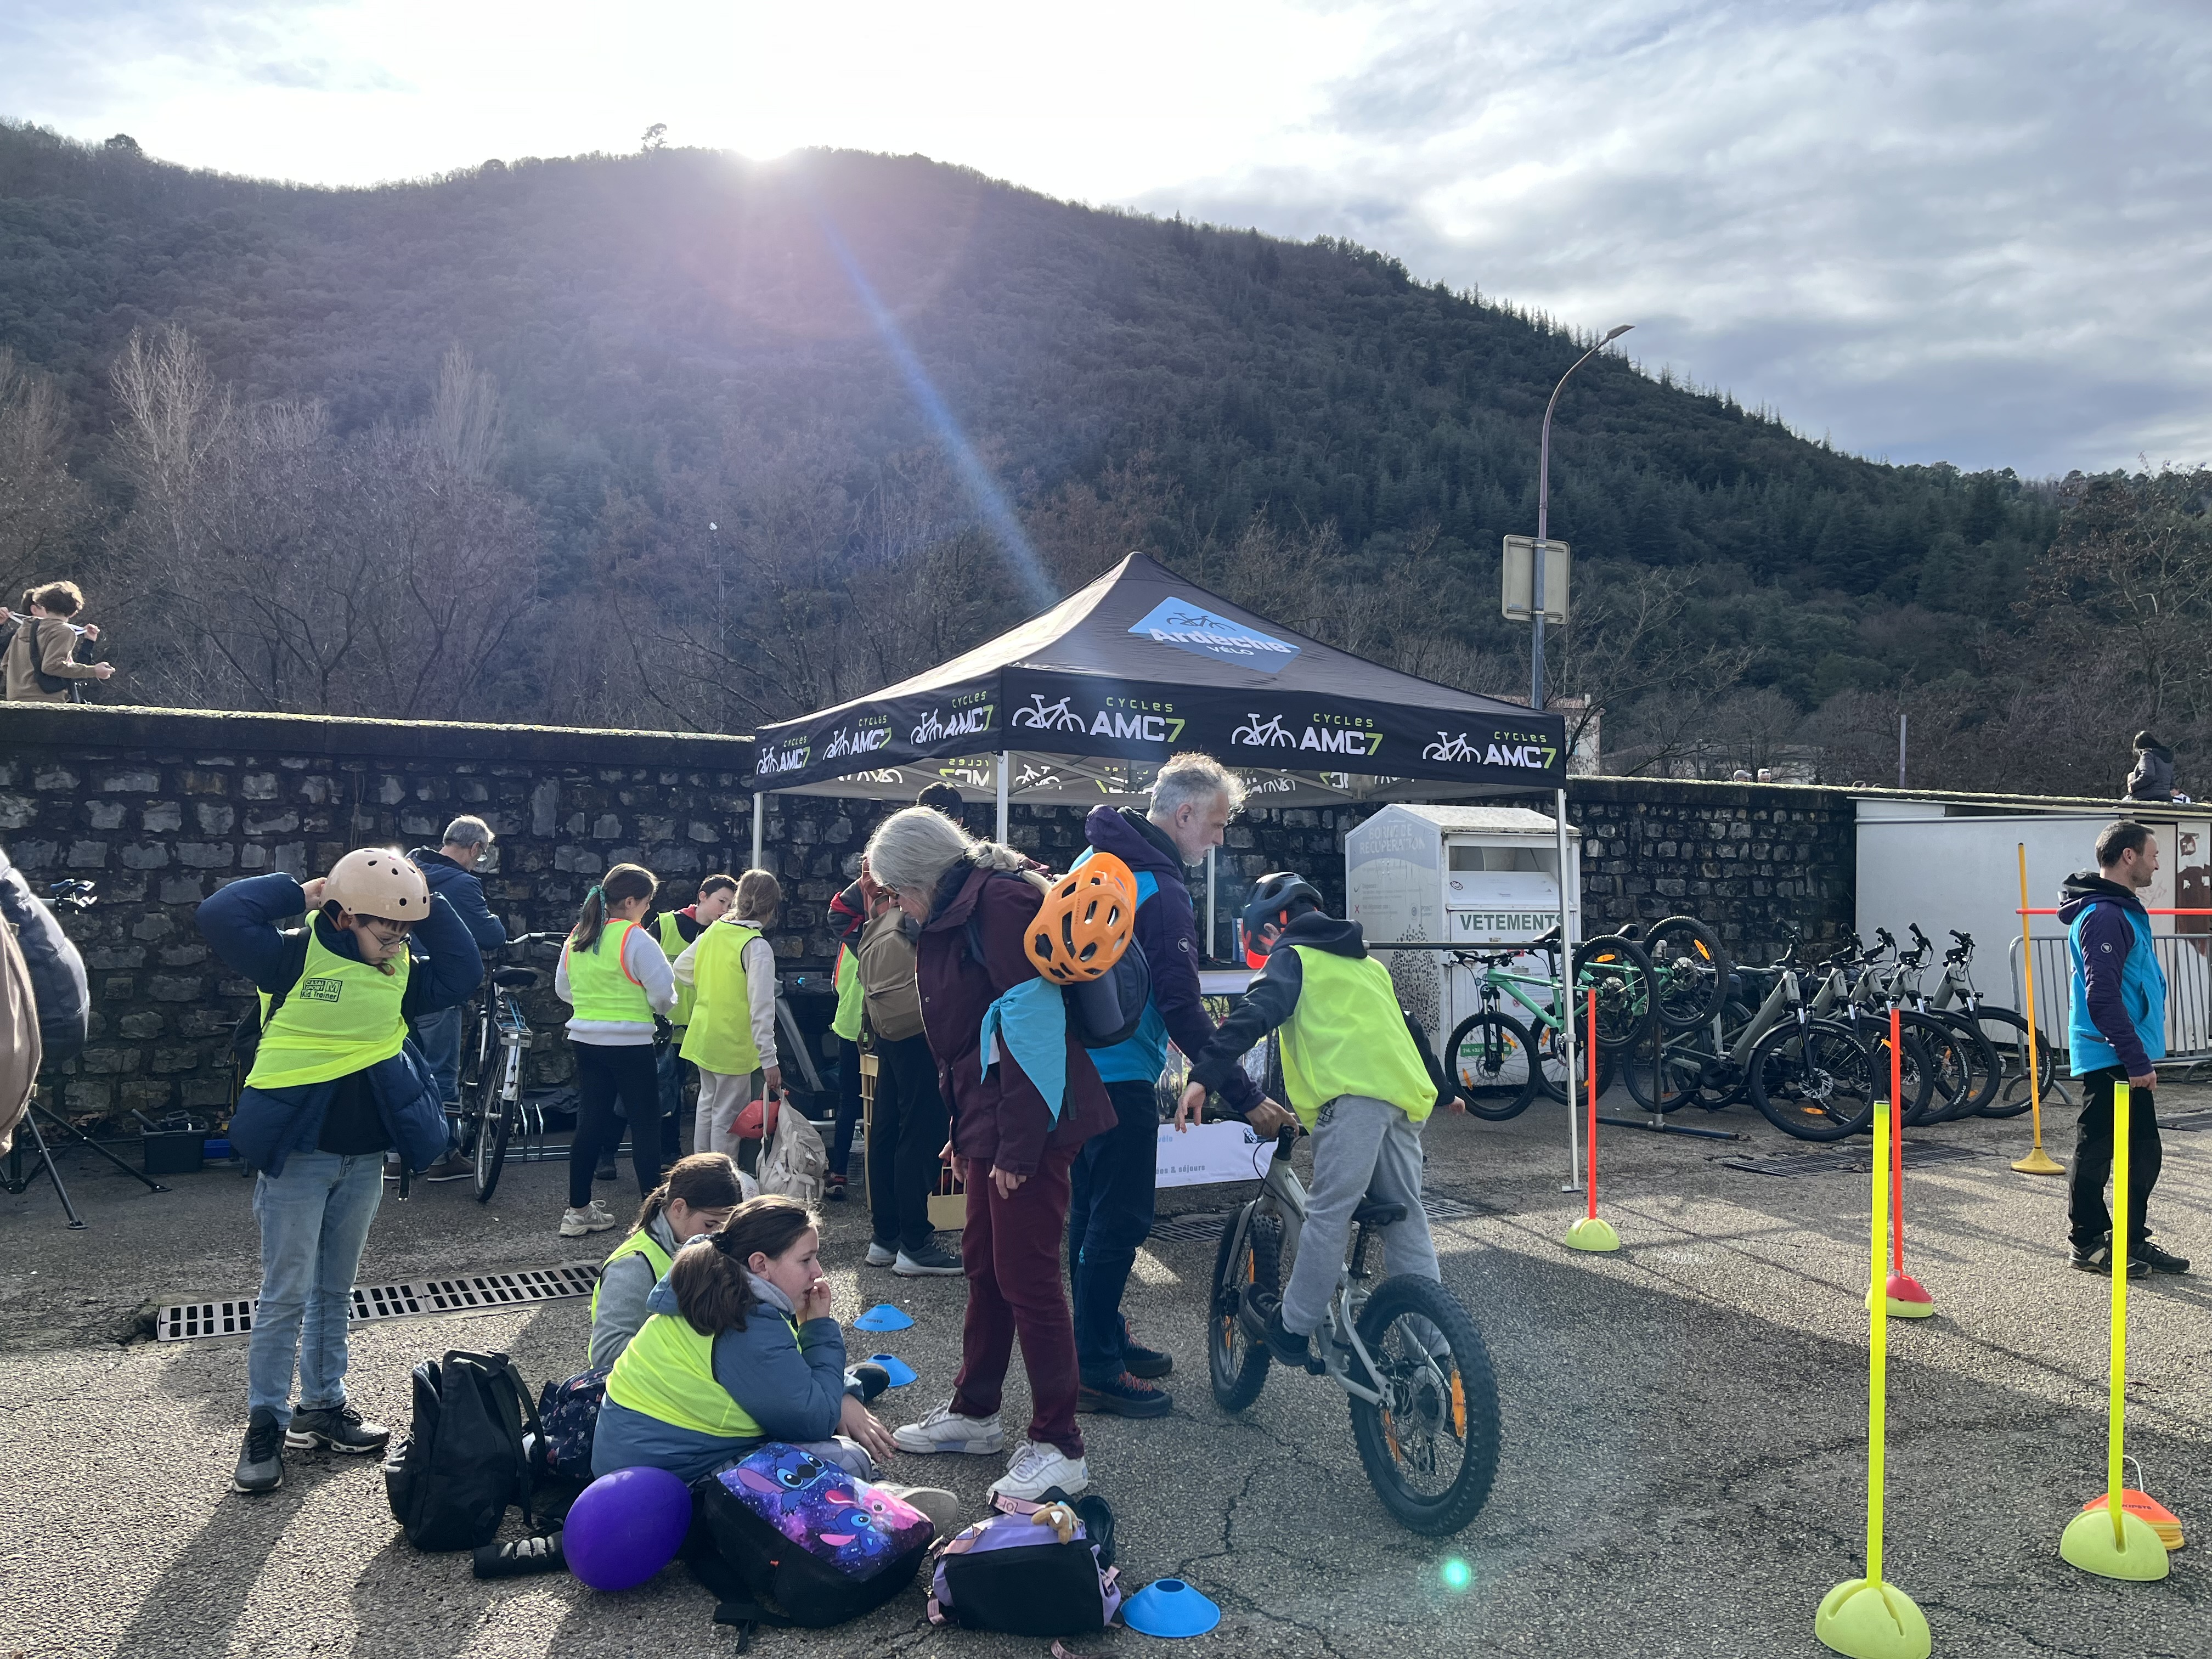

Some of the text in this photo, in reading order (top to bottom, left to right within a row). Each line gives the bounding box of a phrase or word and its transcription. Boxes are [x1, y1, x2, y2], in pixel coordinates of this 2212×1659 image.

[1149, 628, 1291, 653] Ardèche
[1206, 645, 1255, 656] VÉLO
[943, 704, 994, 739] AMC7
[1090, 710, 1186, 743] AMC7
[850, 727, 892, 755] AMC7
[1299, 726, 1384, 756] AMC7
[778, 746, 811, 772] AMC7
[1482, 743, 1557, 769] AMC7
[1369, 823, 1413, 839] BORNE DE
[314, 991, 337, 1000] Trainer
[1845, 1035, 1867, 1054] PYTHON
[1953, 1085, 1967, 1106] PYTHON
[1178, 1164, 1205, 1173] séjours
